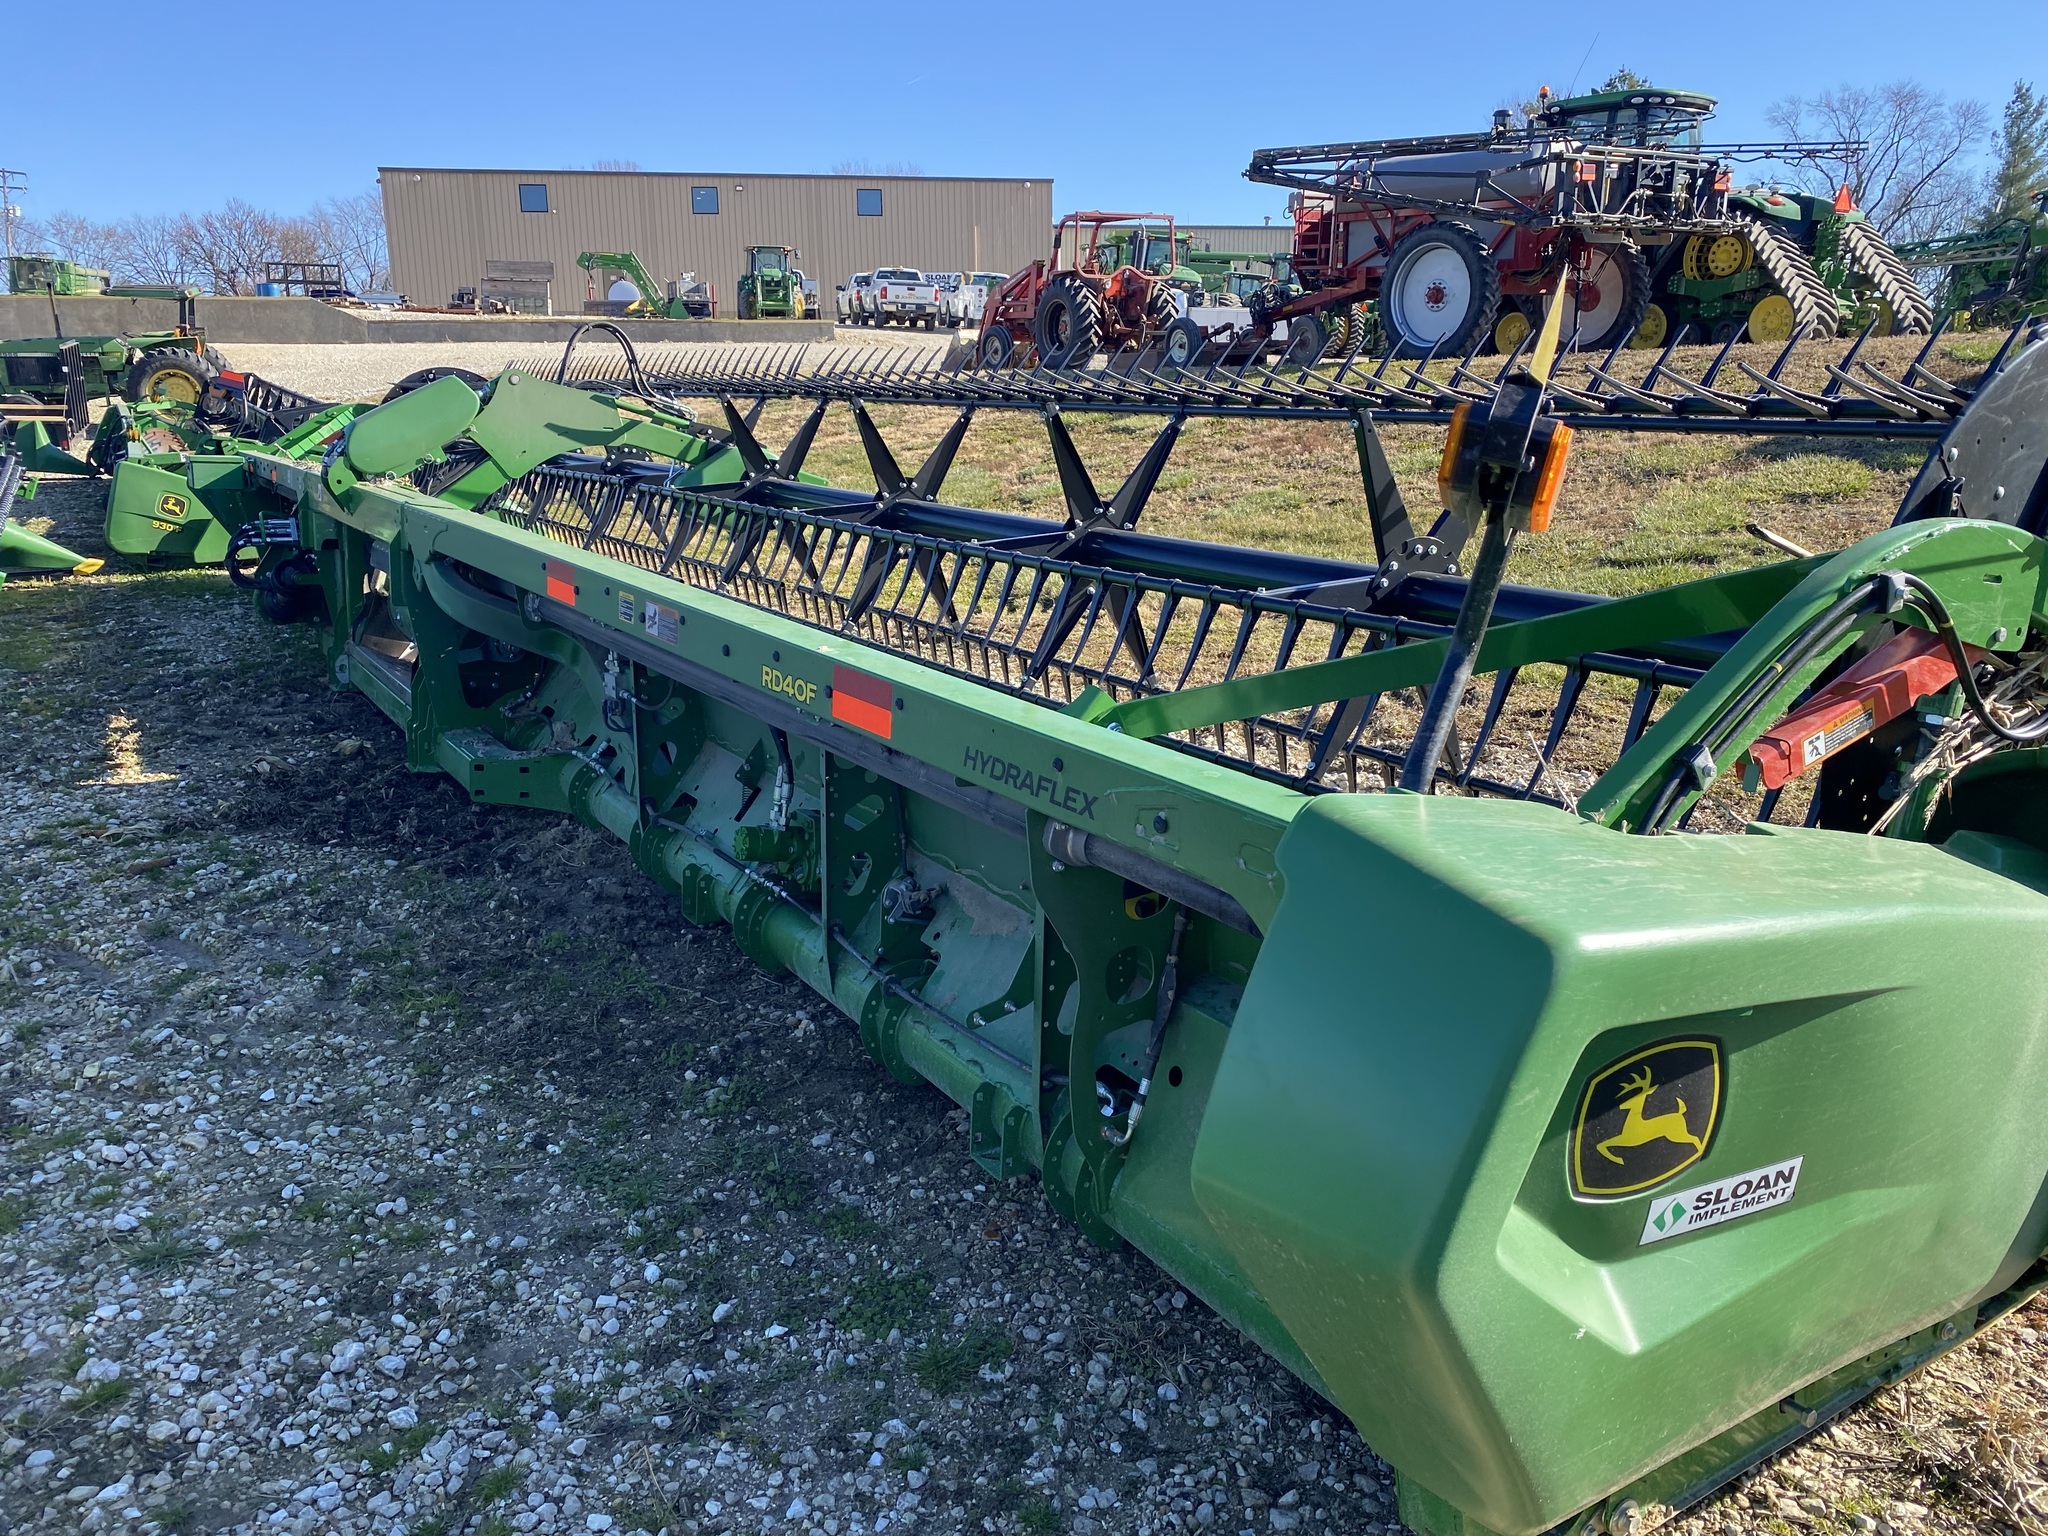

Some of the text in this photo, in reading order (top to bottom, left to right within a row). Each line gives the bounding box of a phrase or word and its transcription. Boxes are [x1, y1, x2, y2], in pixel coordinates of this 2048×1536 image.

[762, 665, 818, 705] RD40F
[1838, 703, 1867, 725] WARNING
[963, 746, 1099, 821] HYDRAFLEX
[1688, 1186, 1790, 1225] IMPLEMENT
[1692, 1166, 1796, 1211] SLOAN
